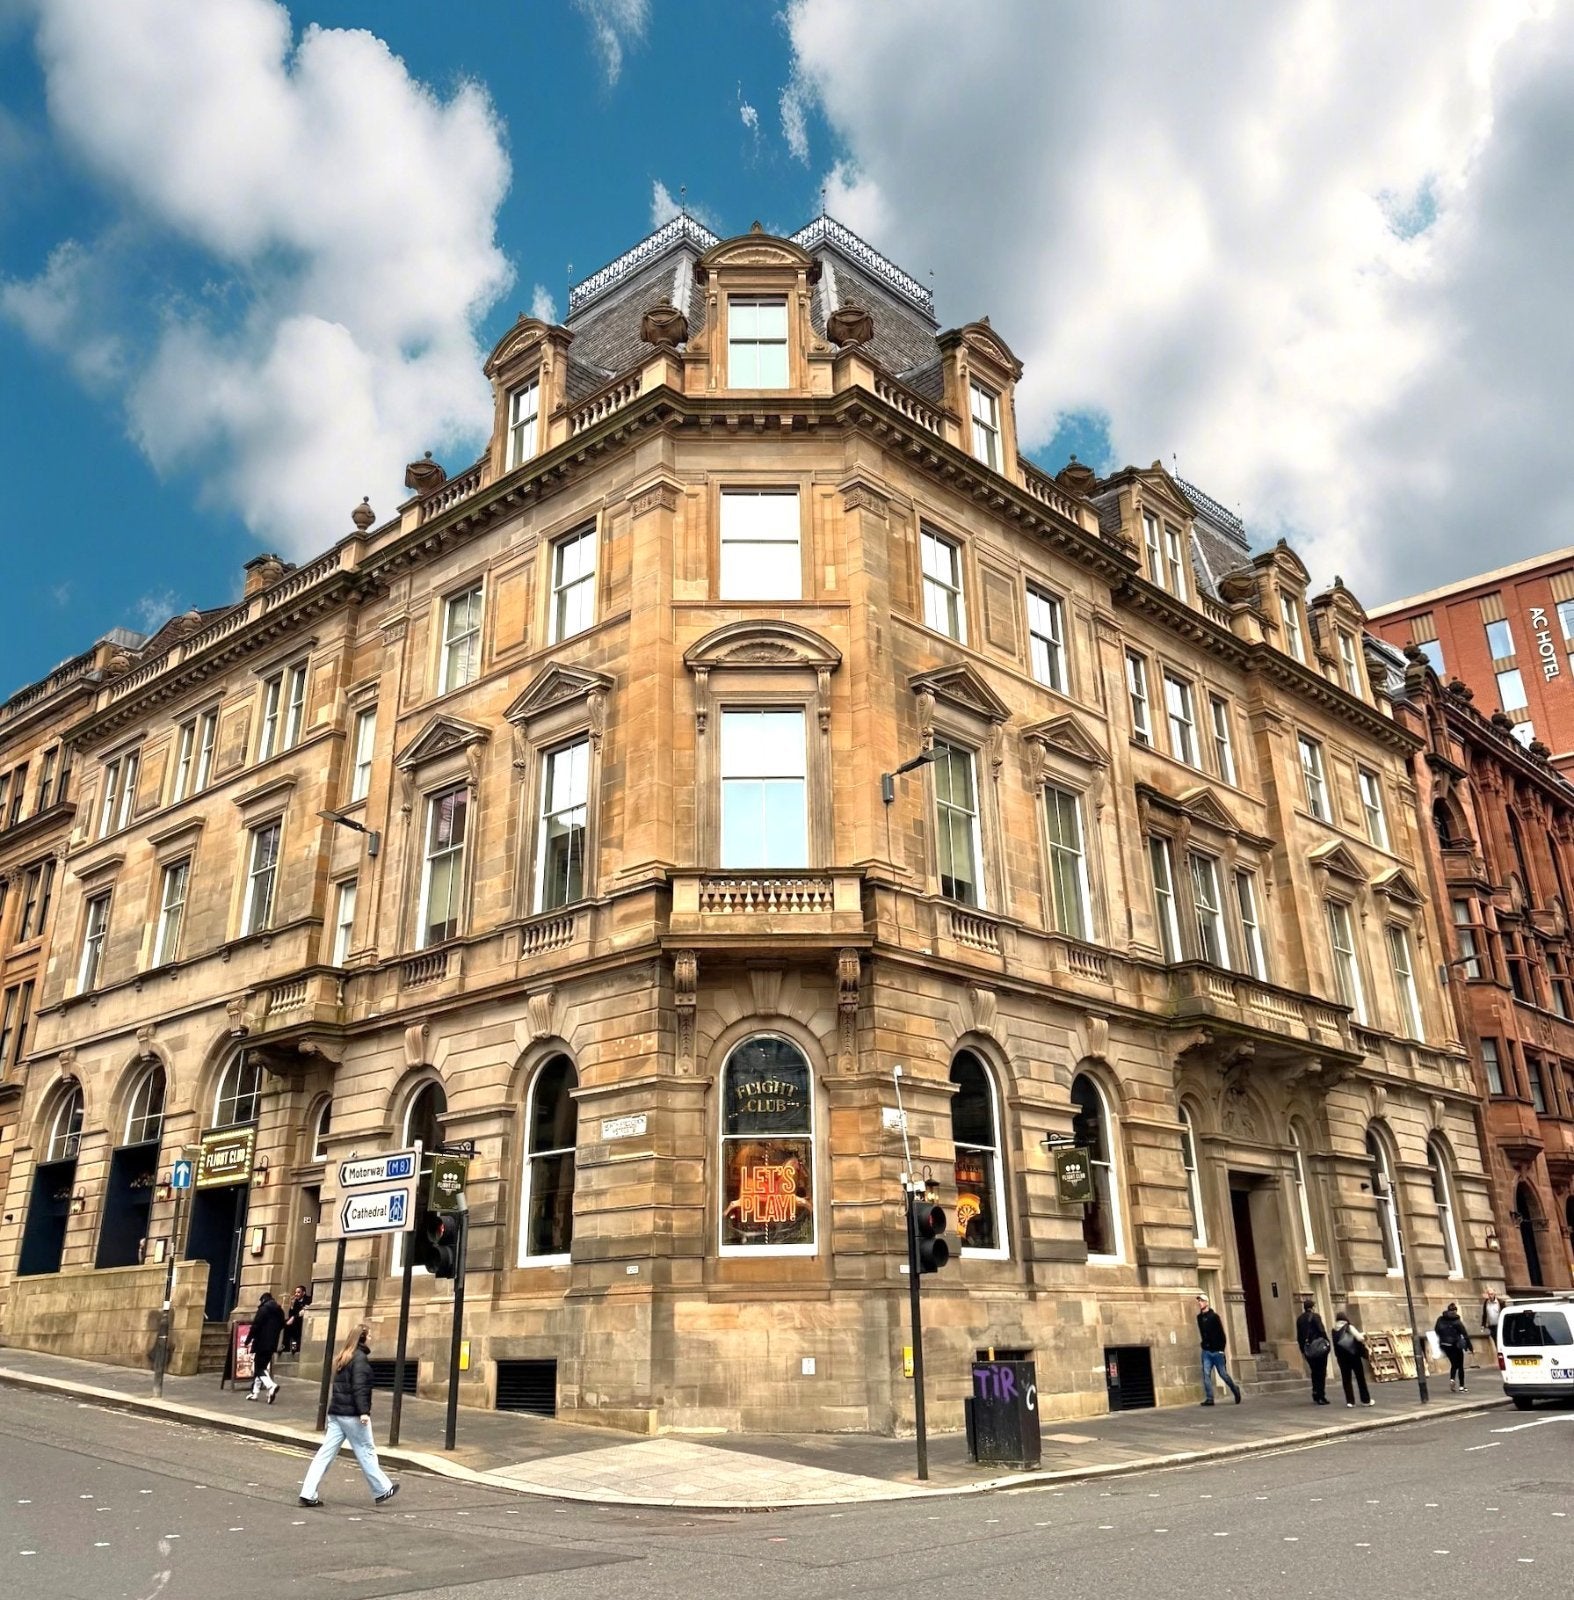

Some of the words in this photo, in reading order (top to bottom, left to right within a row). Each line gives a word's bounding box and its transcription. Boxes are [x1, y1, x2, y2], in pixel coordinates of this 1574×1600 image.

[1529, 607, 1548, 629] AC
[1535, 630, 1560, 682] HOTEL
[737, 1080, 798, 1099] FLIGHT
[747, 1099, 787, 1112] CLUB
[206, 1151, 229, 1168] FLIGHT
[229, 1148, 246, 1164] CLUB
[349, 1166, 385, 1179] Motorway
[741, 1166, 796, 1193] LET'S
[352, 1205, 387, 1220] Cathedral
[741, 1194, 796, 1222] PLAY!
